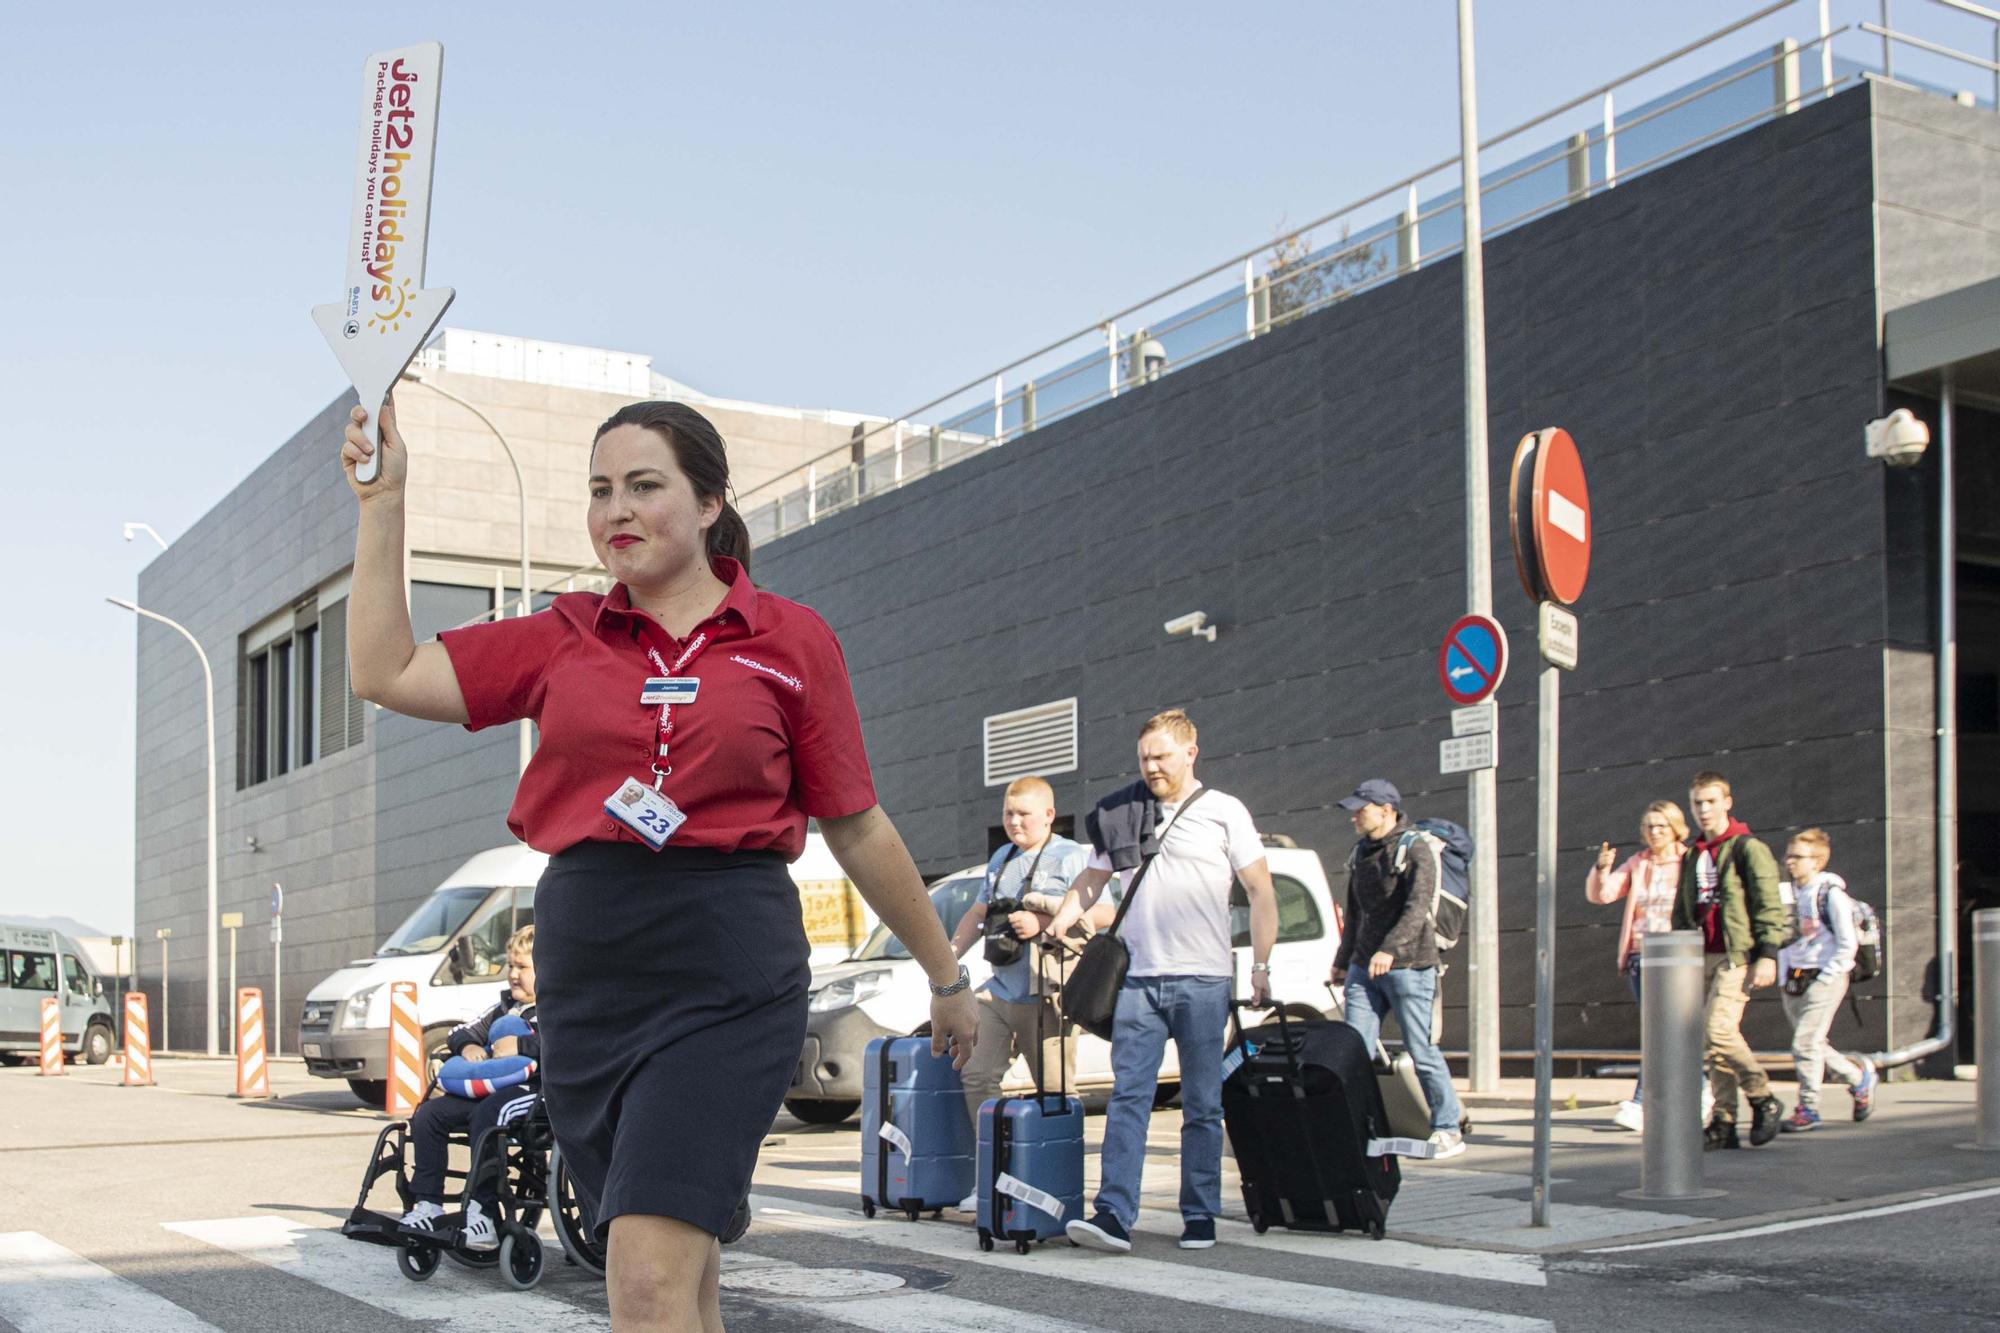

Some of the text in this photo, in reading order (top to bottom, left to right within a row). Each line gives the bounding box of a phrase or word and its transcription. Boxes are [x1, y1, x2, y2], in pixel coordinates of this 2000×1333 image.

[361, 61, 388, 263] Package holidays you can trust
[367, 58, 418, 302] Jet2holidays
[352, 296, 361, 316] ABTA
[729, 655, 796, 686] Jet2holidays
[637, 809, 670, 834] 23
